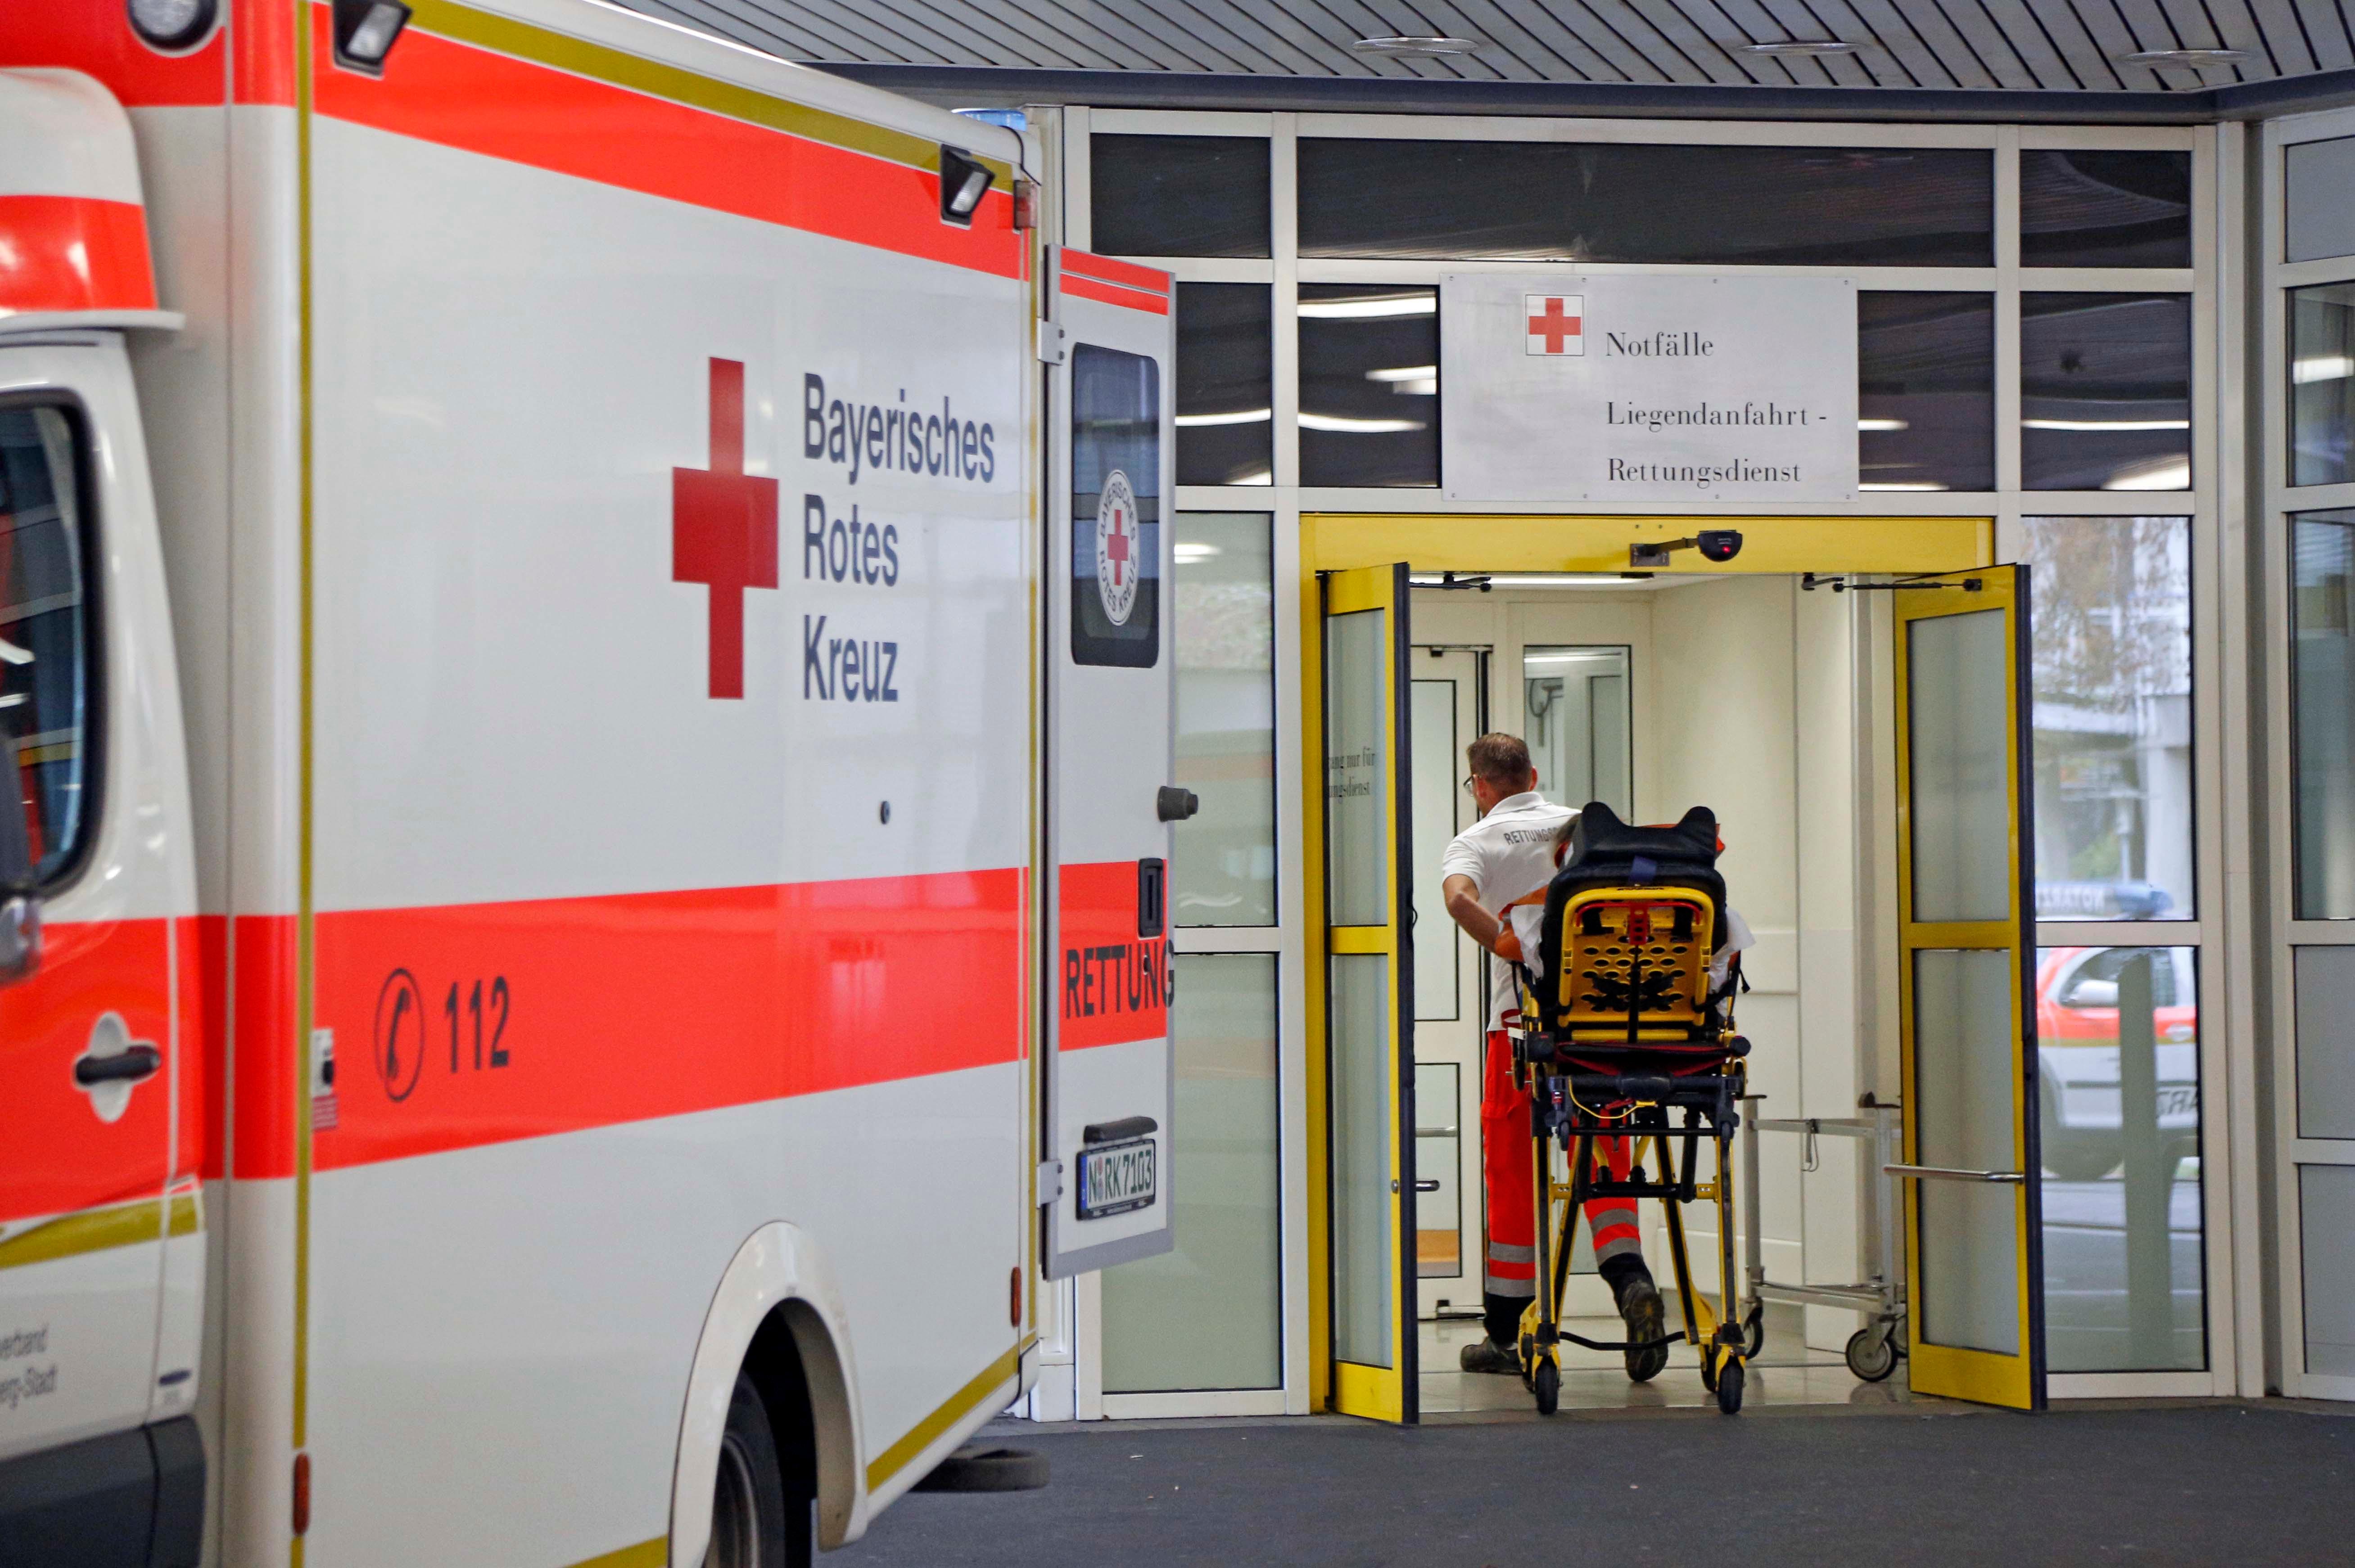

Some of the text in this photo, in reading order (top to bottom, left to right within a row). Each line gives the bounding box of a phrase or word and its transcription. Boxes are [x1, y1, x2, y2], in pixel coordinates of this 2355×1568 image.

[1605, 331, 1714, 357] Notfälle
[804, 373, 995, 485] Bayerisches
[1606, 401, 1809, 433] Liegendanfahrt
[1608, 458, 1801, 488] Rettungsdienst
[804, 494, 899, 587] Rotes
[804, 614, 899, 703] Kreuz
[1066, 939, 1175, 1019] RETTUNG
[446, 976, 509, 1072] 112
[1123, 1149, 1152, 1196] 7103
